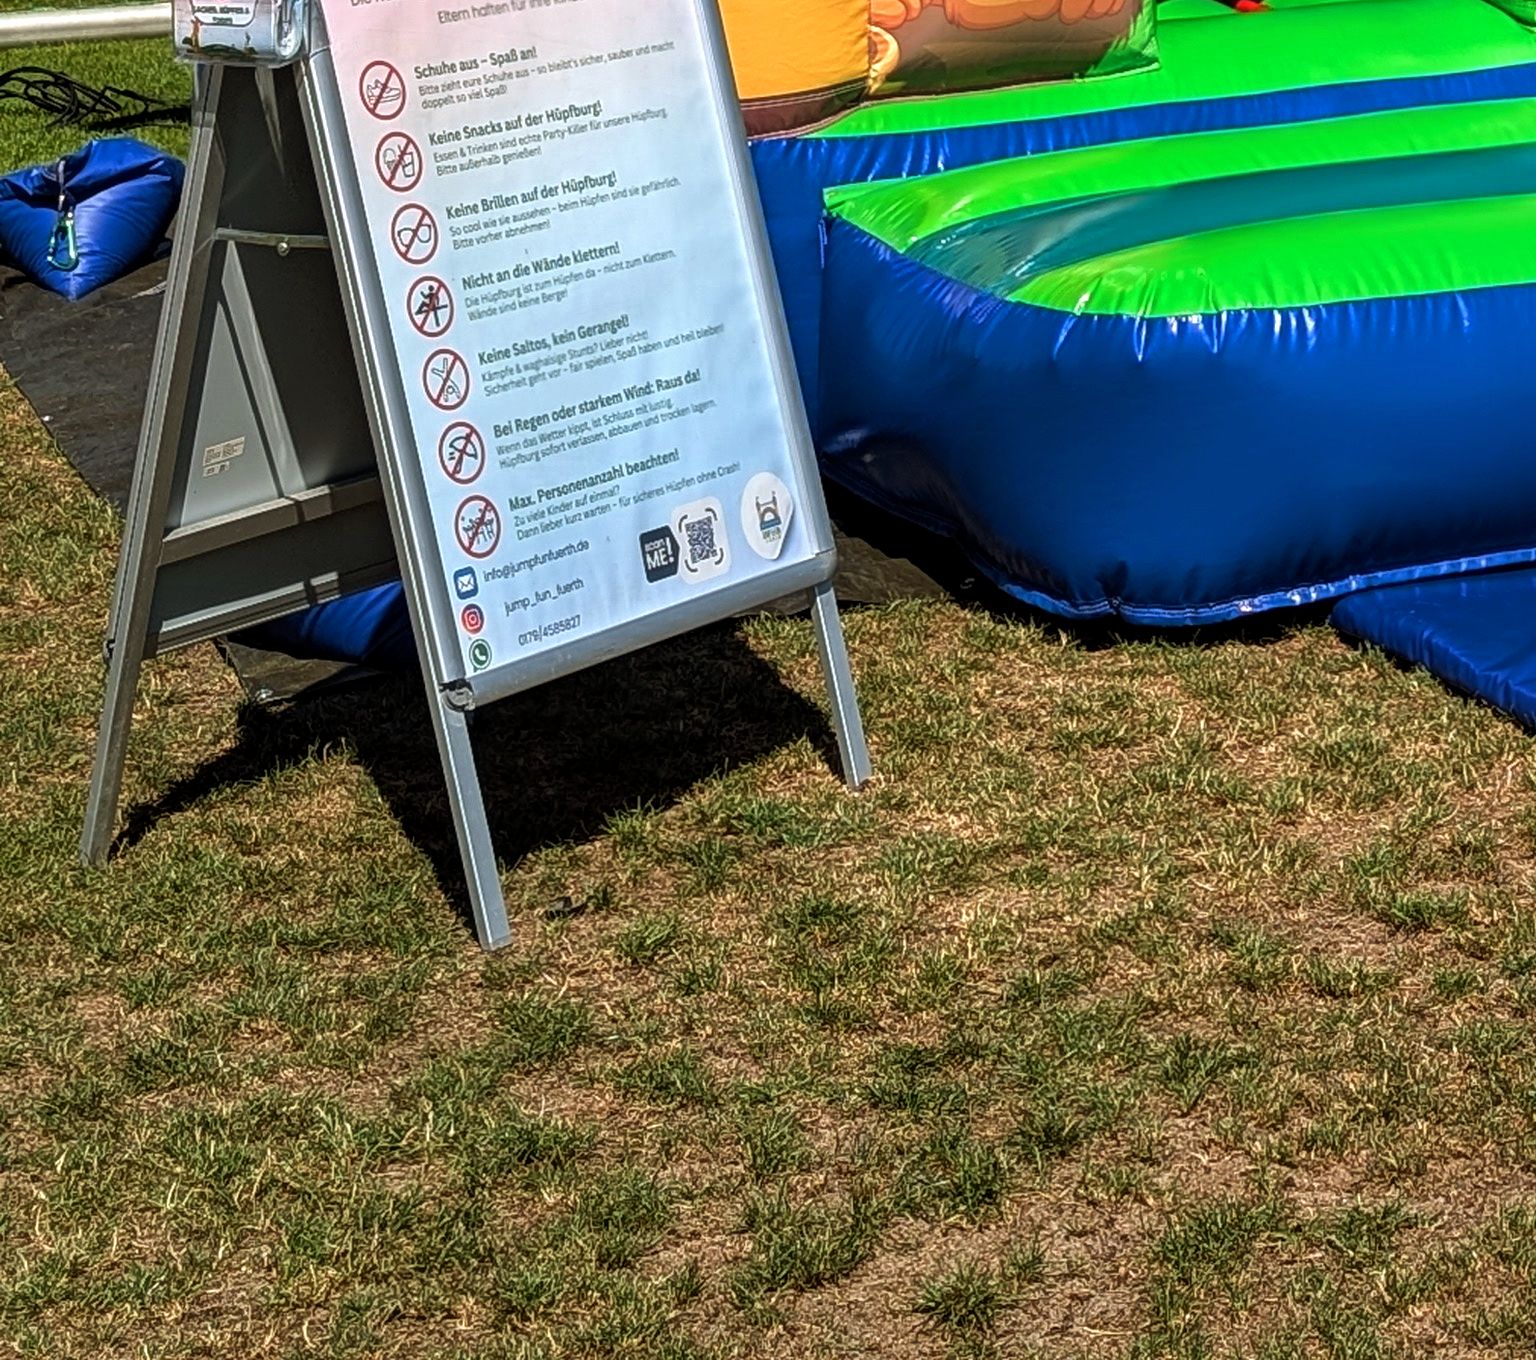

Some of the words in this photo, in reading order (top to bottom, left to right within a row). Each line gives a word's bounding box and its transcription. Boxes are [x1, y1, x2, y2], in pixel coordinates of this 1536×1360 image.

[436, 9, 470, 24] Eltern
[470, 2, 510, 18] haften
[413, 60, 457, 79] Schuhe
[458, 58, 479, 71] aus
[488, 47, 518, 68] Spaß
[519, 46, 537, 60] an!
[428, 129, 462, 146] Keine
[462, 120, 503, 139] Snacks
[504, 114, 522, 131] auf
[524, 113, 543, 127] der
[544, 99, 602, 123] Hüpfburg!
[445, 202, 479, 219] Keine
[480, 194, 519, 211] Brillen
[520, 186, 538, 203] auf
[540, 184, 559, 199] der
[560, 170, 617, 194] Hüpfburg!
[461, 272, 495, 290] Nicht
[495, 269, 511, 282] an
[512, 263, 530, 278] die
[530, 253, 571, 273] Wände
[571, 241, 620, 264] klettern!
[477, 347, 511, 365] Keine
[511, 338, 551, 356] Saltos,
[551, 328, 576, 345] kein
[577, 314, 629, 339] Gerangel!
[492, 420, 513, 438] Bei
[514, 413, 550, 432] Regen
[551, 404, 576, 421] oder
[577, 392, 622, 414] starkem
[622, 380, 655, 401] Wind:
[654, 375, 683, 392] Raus
[683, 368, 700, 384] da!
[508, 495, 536, 511] Max.
[536, 463, 624, 503] Personenanzahl
[624, 447, 679, 475] beachten!
[646, 537, 675, 570] ME!
[504, 577, 584, 617] jump_fun_fuerth
